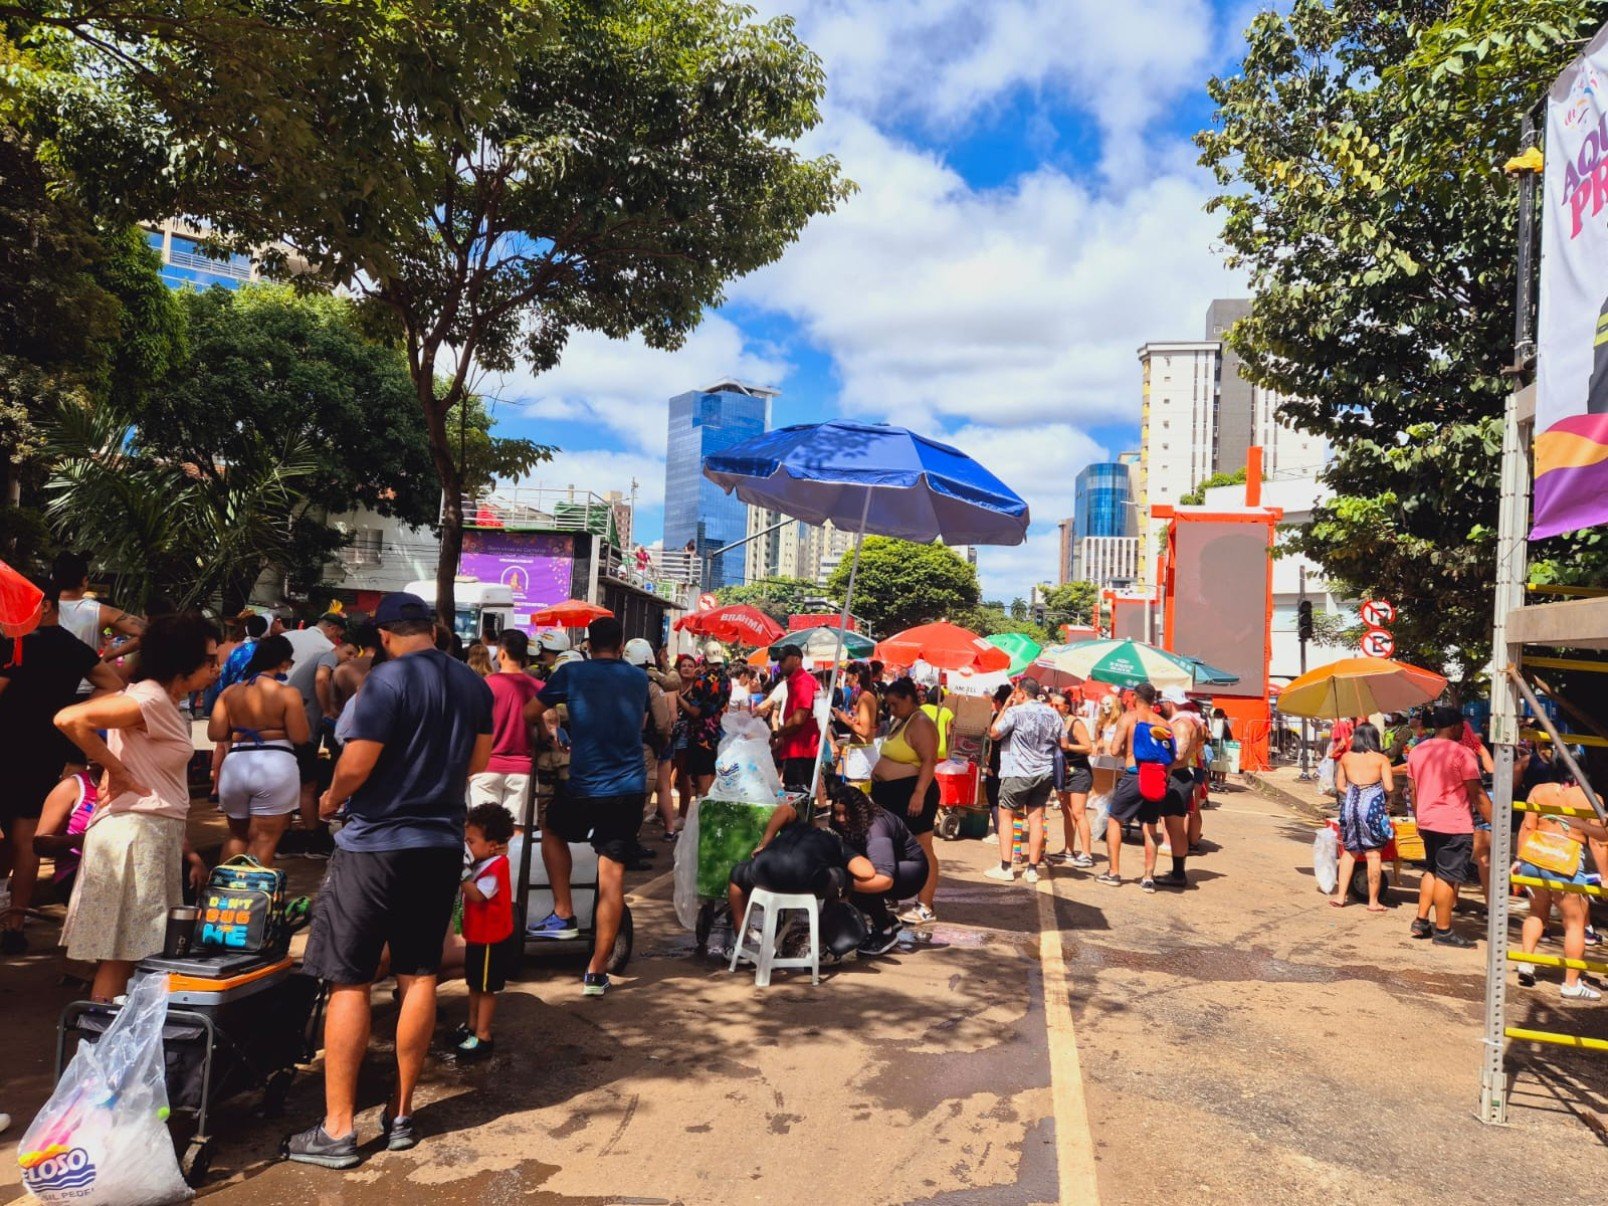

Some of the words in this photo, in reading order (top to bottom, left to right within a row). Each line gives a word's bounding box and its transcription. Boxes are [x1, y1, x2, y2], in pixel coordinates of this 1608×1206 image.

[720, 613, 763, 635] BRAHMA
[206, 908, 251, 924] BUG
[202, 923, 248, 947] ME
